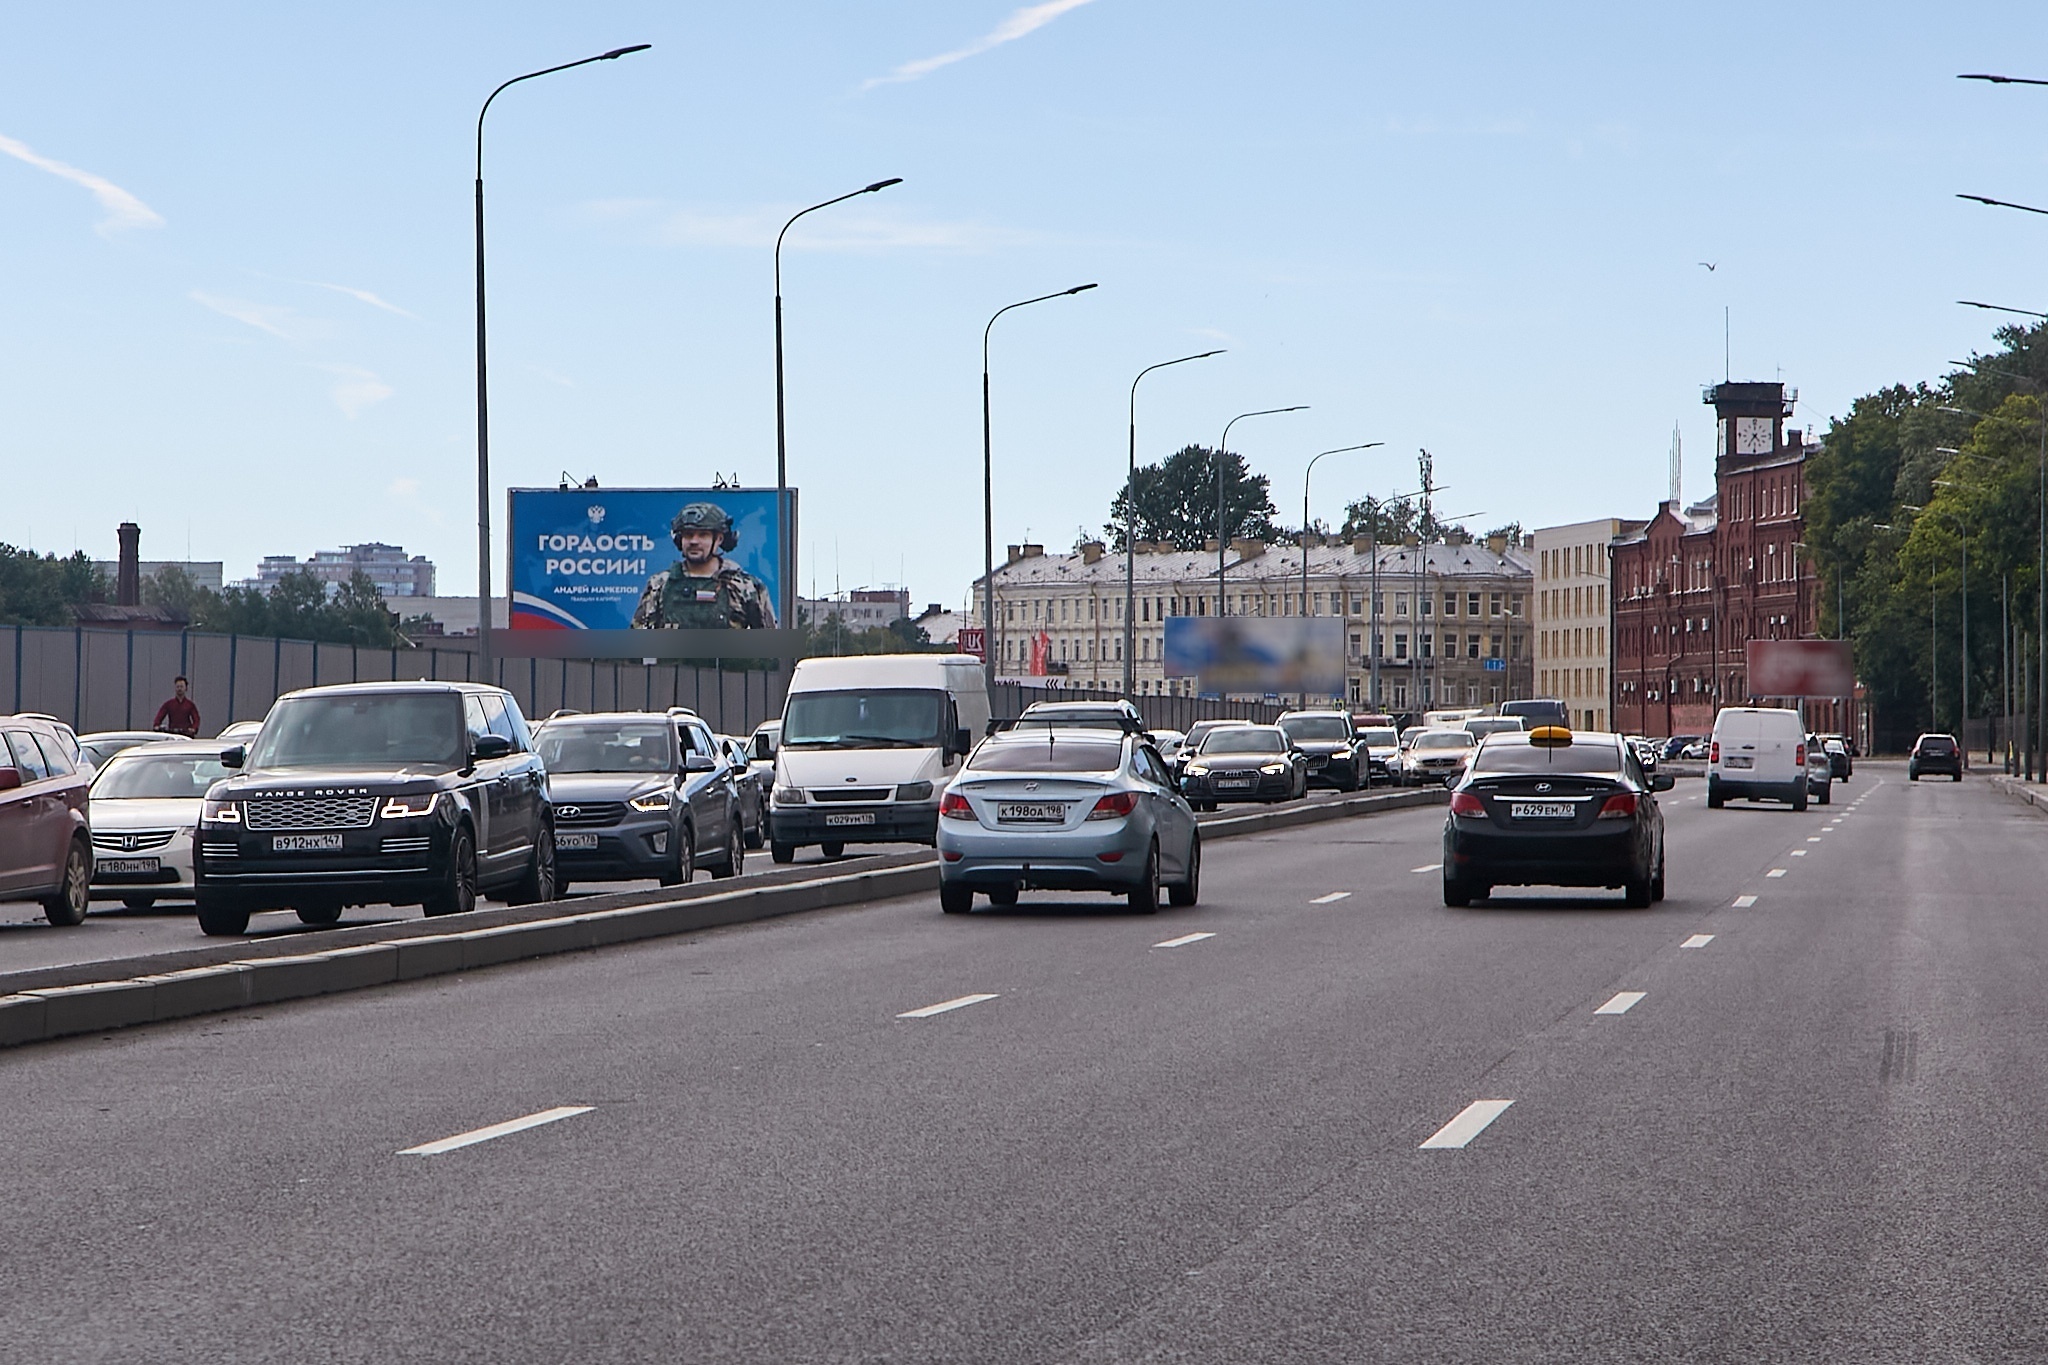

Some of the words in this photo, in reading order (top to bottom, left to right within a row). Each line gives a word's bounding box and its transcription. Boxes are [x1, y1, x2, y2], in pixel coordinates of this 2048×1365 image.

[538, 534, 655, 553] ГОРДОСТЬ
[546, 558, 646, 576] РОССИИ!
[553, 584, 589, 594] АНДРЕЙ
[591, 586, 638, 594] МАРКЕЛОВ
[315, 788, 368, 796] ROVER
[1001, 805, 1043, 817] К198ОА
[1045, 804, 1062, 814] 198
[1515, 804, 1558, 815] Р629ЕМ
[1561, 804, 1572, 813] 70
[276, 836, 320, 849] В912НХ
[323, 835, 340, 846] 147
[142, 860, 156, 869] 198
